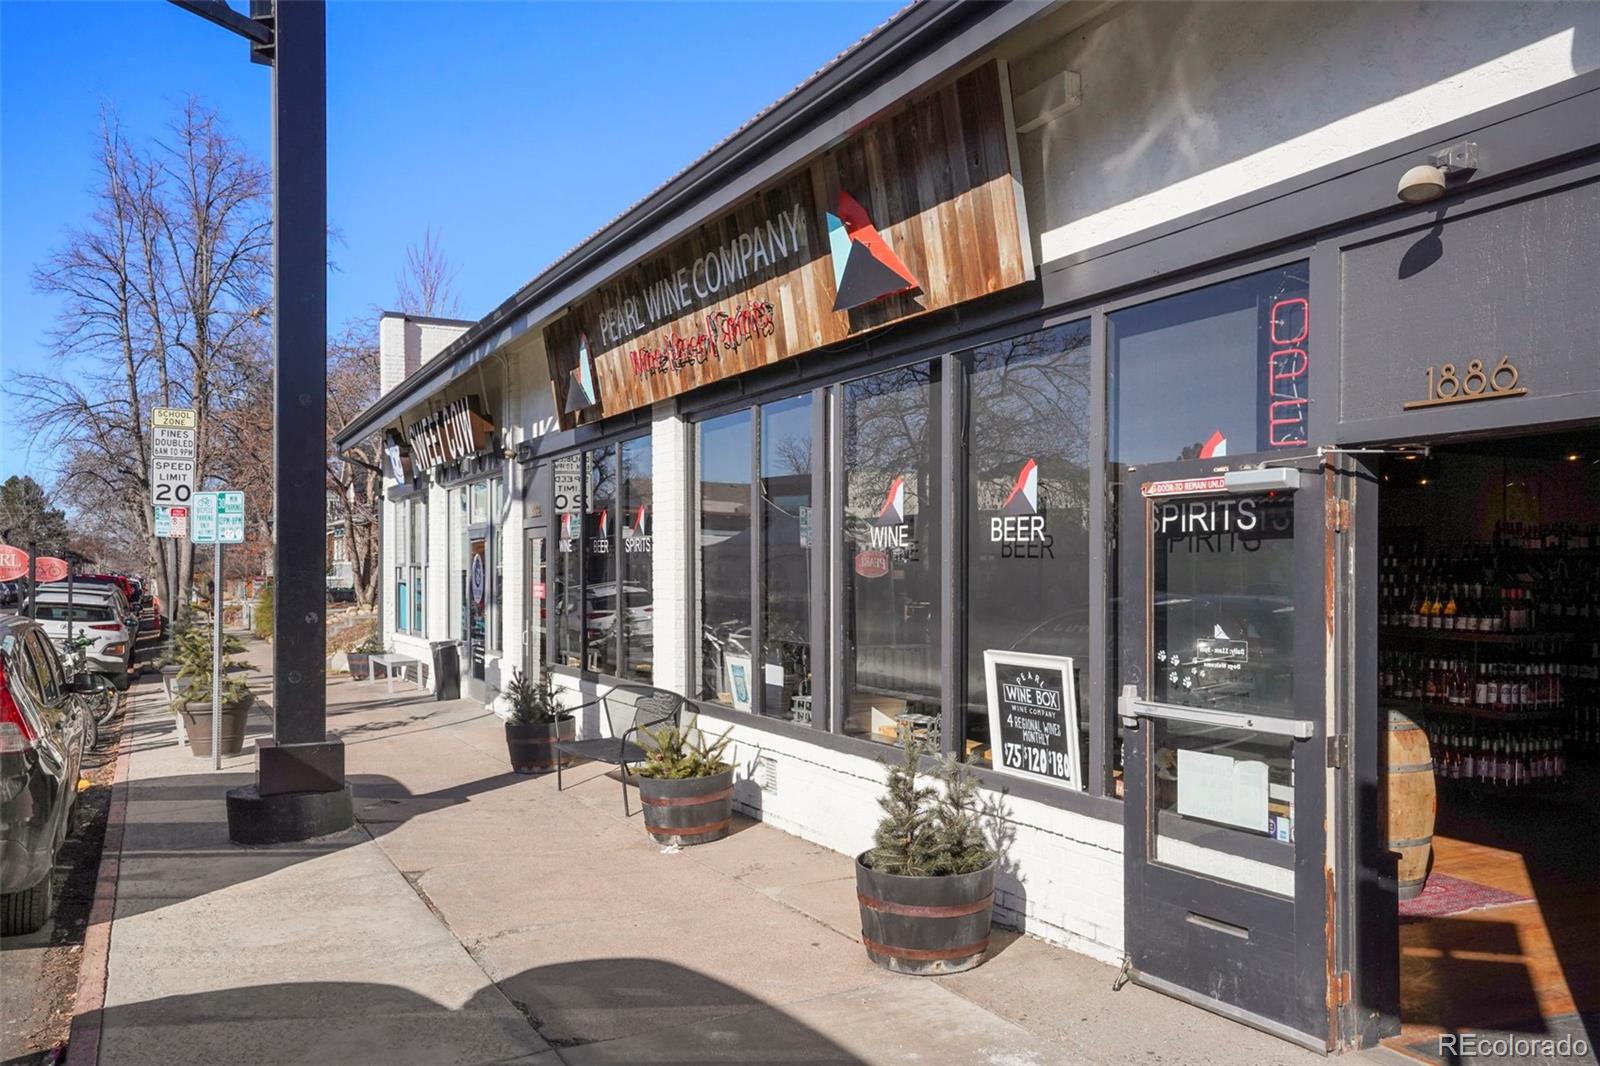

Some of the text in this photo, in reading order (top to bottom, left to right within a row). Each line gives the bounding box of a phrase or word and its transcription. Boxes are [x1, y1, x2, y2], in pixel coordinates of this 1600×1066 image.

[599, 203, 801, 346] PEARL WINE COMPANY
[1269, 298, 1310, 447] OPE
[1426, 355, 1518, 401] 1886
[158, 411, 191, 419] SCHOOL
[161, 430, 189, 438] FINES
[409, 396, 475, 472] SWEET COW
[155, 439, 193, 447] DOUBLED
[170, 448, 178, 456] TO
[155, 462, 192, 471] SPEED
[156, 484, 191, 501] 20
[1157, 484, 1173, 492] DOOR
[1174, 483, 1183, 491] TO
[1184, 481, 1206, 490] REMAIN
[1208, 480, 1225, 488] UNLO
[870, 525, 909, 547] WINE
[990, 516, 1045, 542] BEER
[594, 539, 609, 553] BEER
[625, 538, 651, 553] SPIRITS
[1016, 672, 1044, 688] PEARL
[1006, 685, 1058, 708] WINE BOX
[1011, 705, 1056, 719] WINE COMPANY
[1007, 713, 1061, 737] 4 REGIONAL WINES
[1022, 730, 1050, 746] MONTHLY
